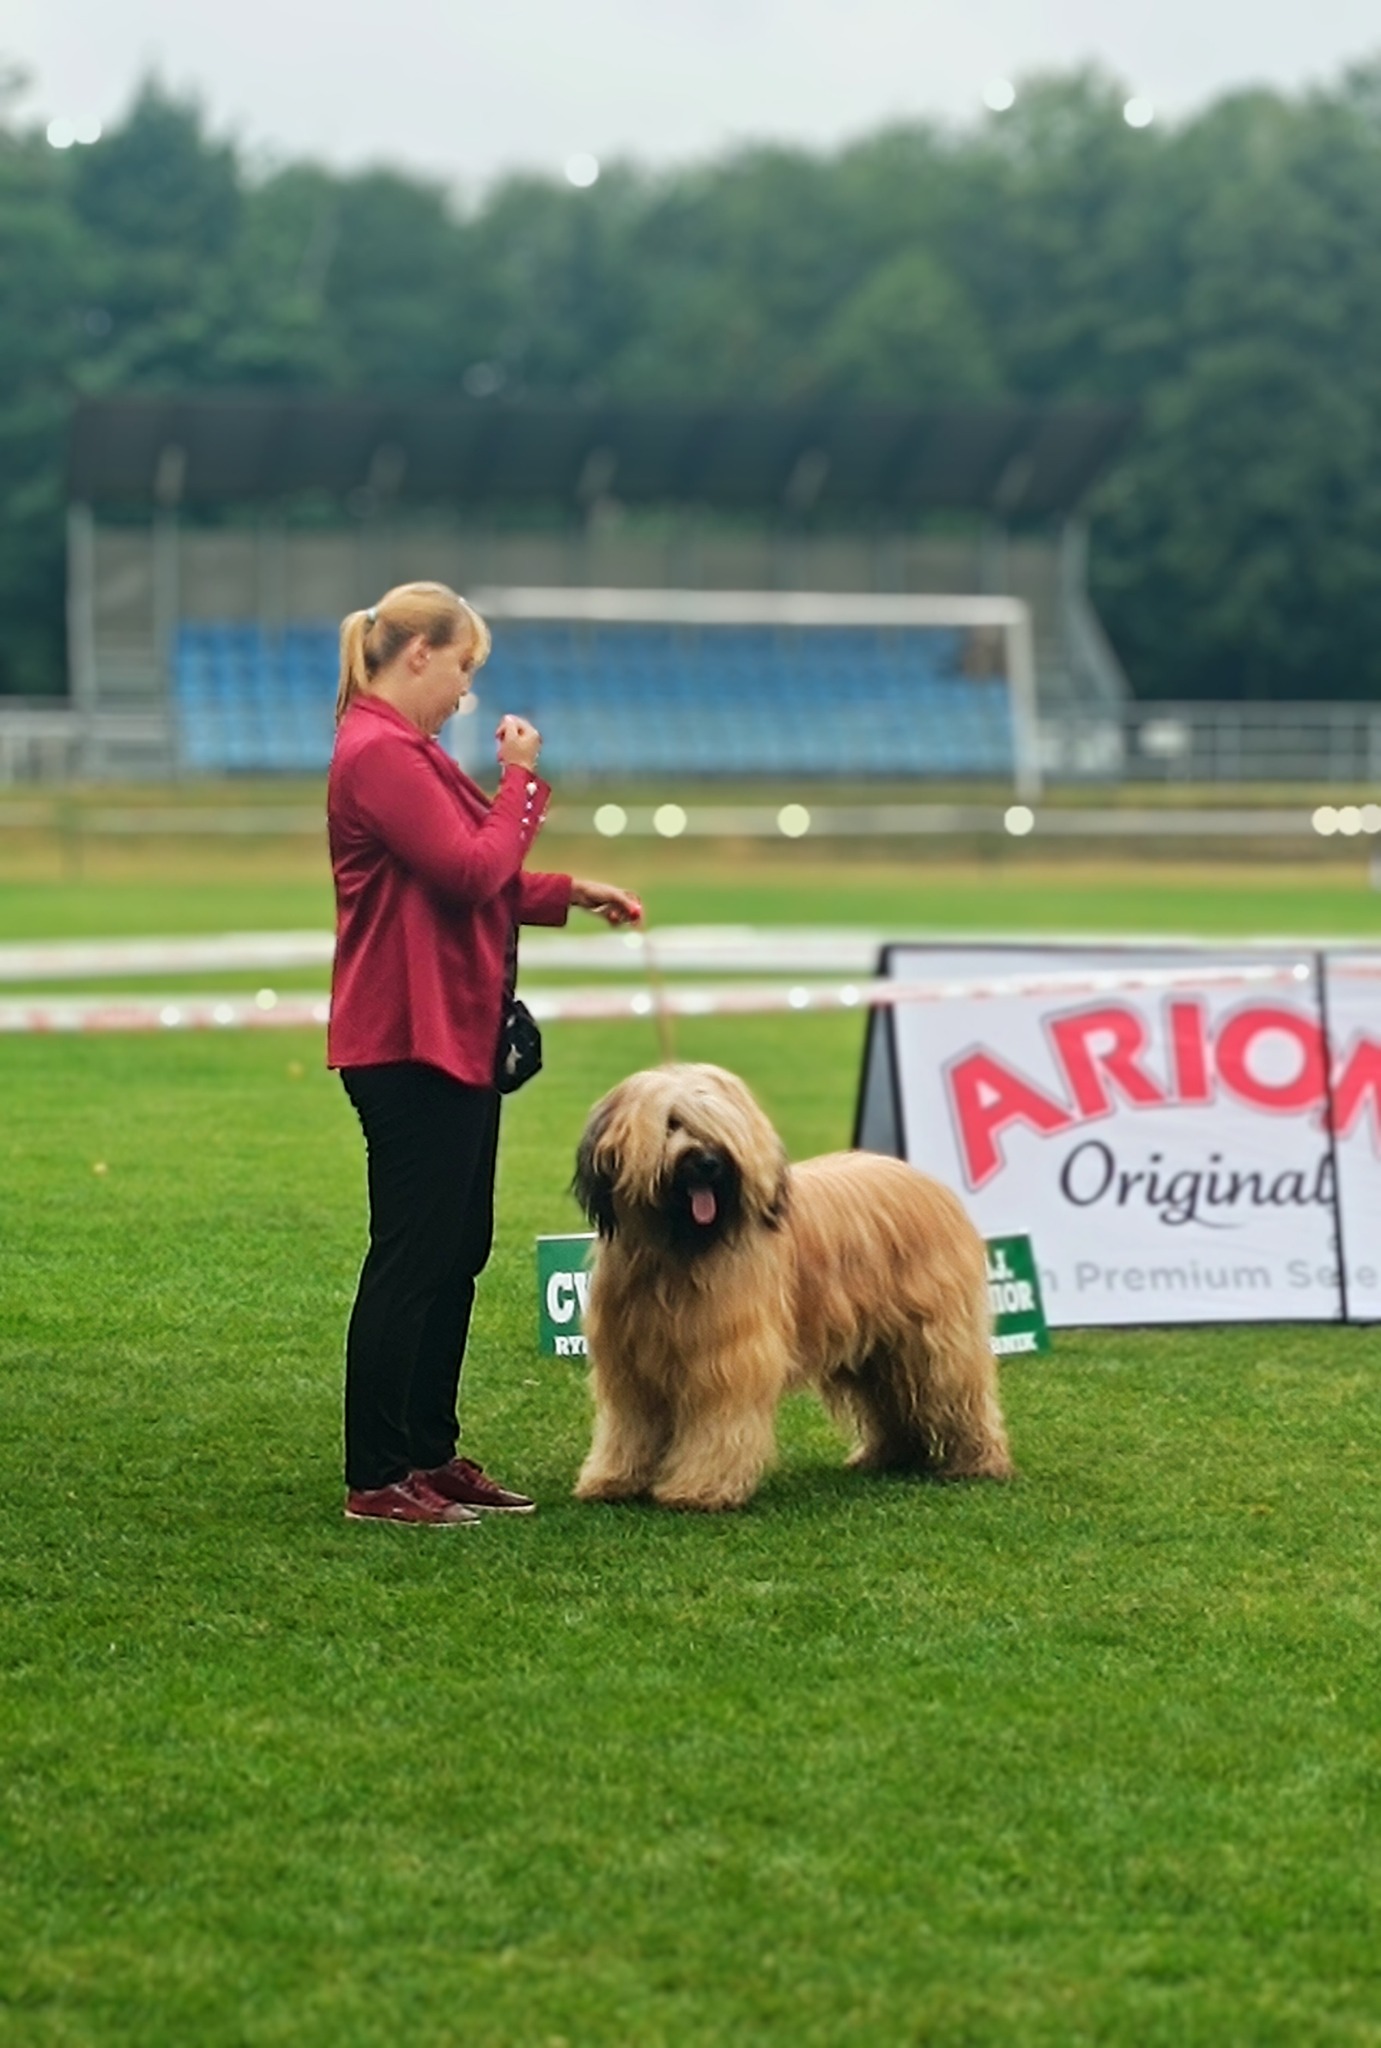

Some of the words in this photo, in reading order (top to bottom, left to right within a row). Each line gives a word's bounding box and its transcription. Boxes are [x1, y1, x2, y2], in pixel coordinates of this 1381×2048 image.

[1059, 1139, 1338, 1229] Original
[1075, 1260, 1272, 1291] Premium
[1286, 1258, 1378, 1290] See
